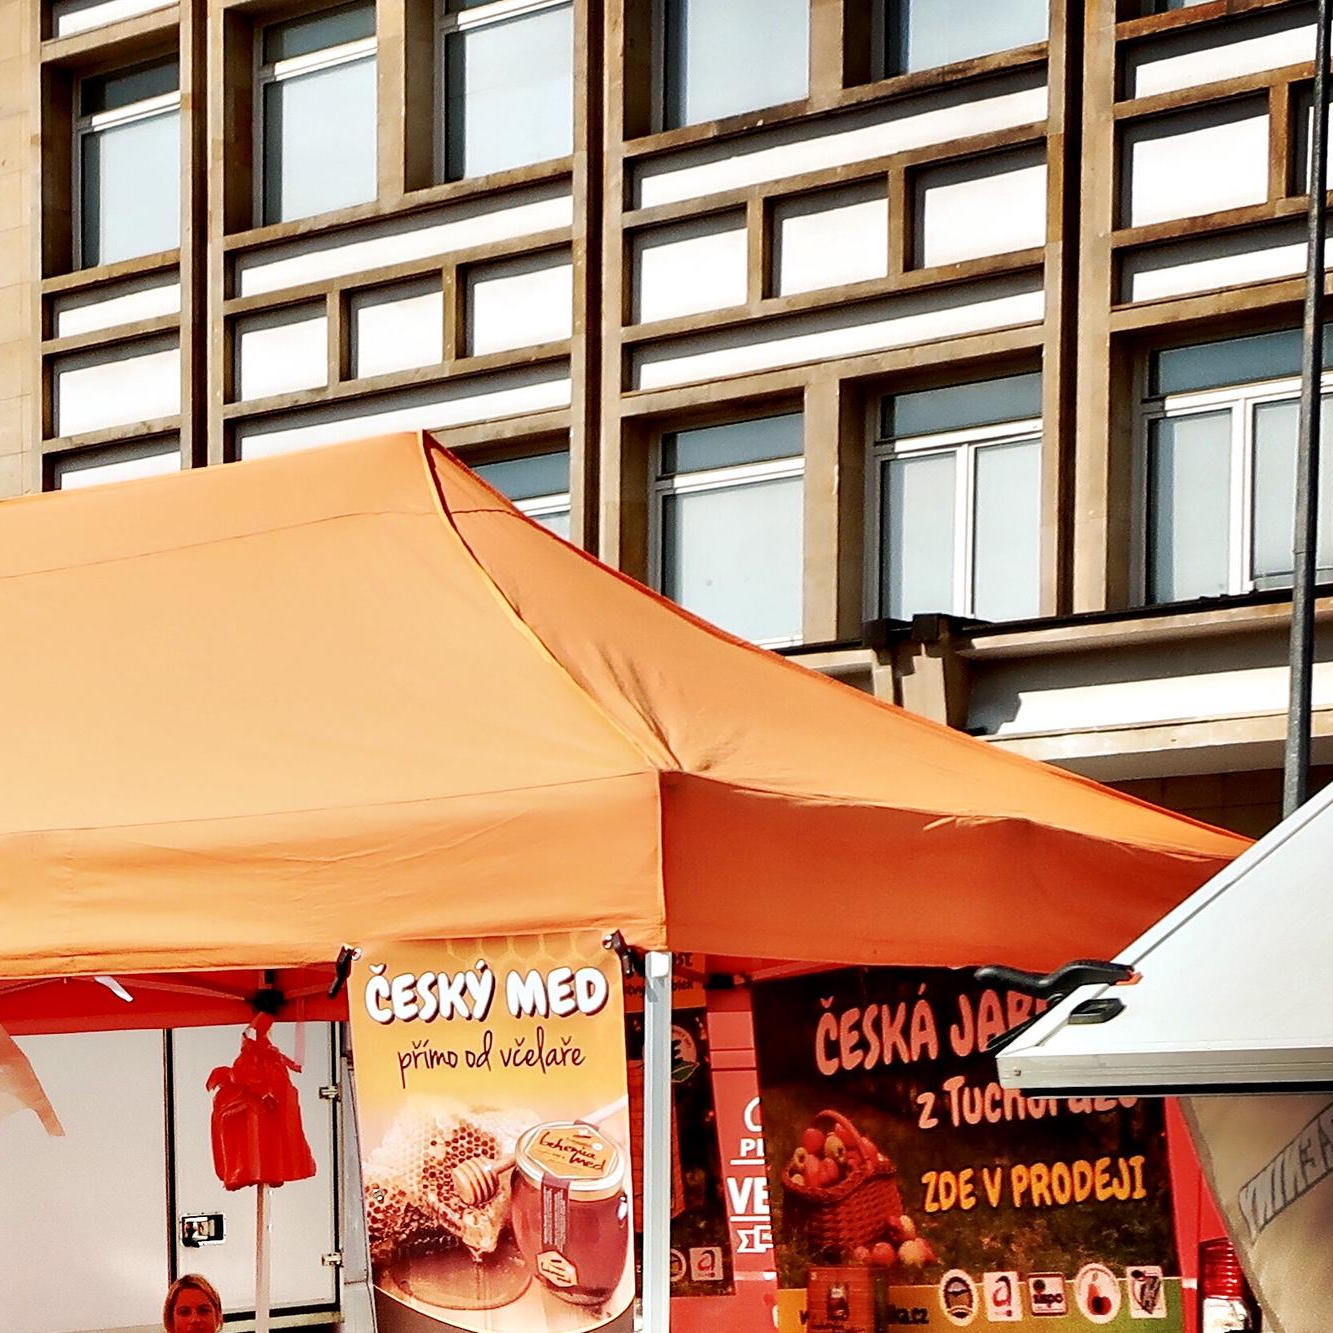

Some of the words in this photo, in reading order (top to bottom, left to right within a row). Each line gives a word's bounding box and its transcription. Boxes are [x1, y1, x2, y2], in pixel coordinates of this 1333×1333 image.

[365, 960, 496, 1024] ČESKÝ
[505, 966, 609, 1019] MED
[398, 1039, 458, 1089] přímo
[465, 1030, 493, 1072] od
[500, 1026, 586, 1075] včelaře
[816, 982, 939, 1076] ČESKÁ
[921, 1167, 976, 1213] ZDE
[983, 1167, 1003, 1208] V
[1011, 1155, 1147, 1208] PRODEJI
